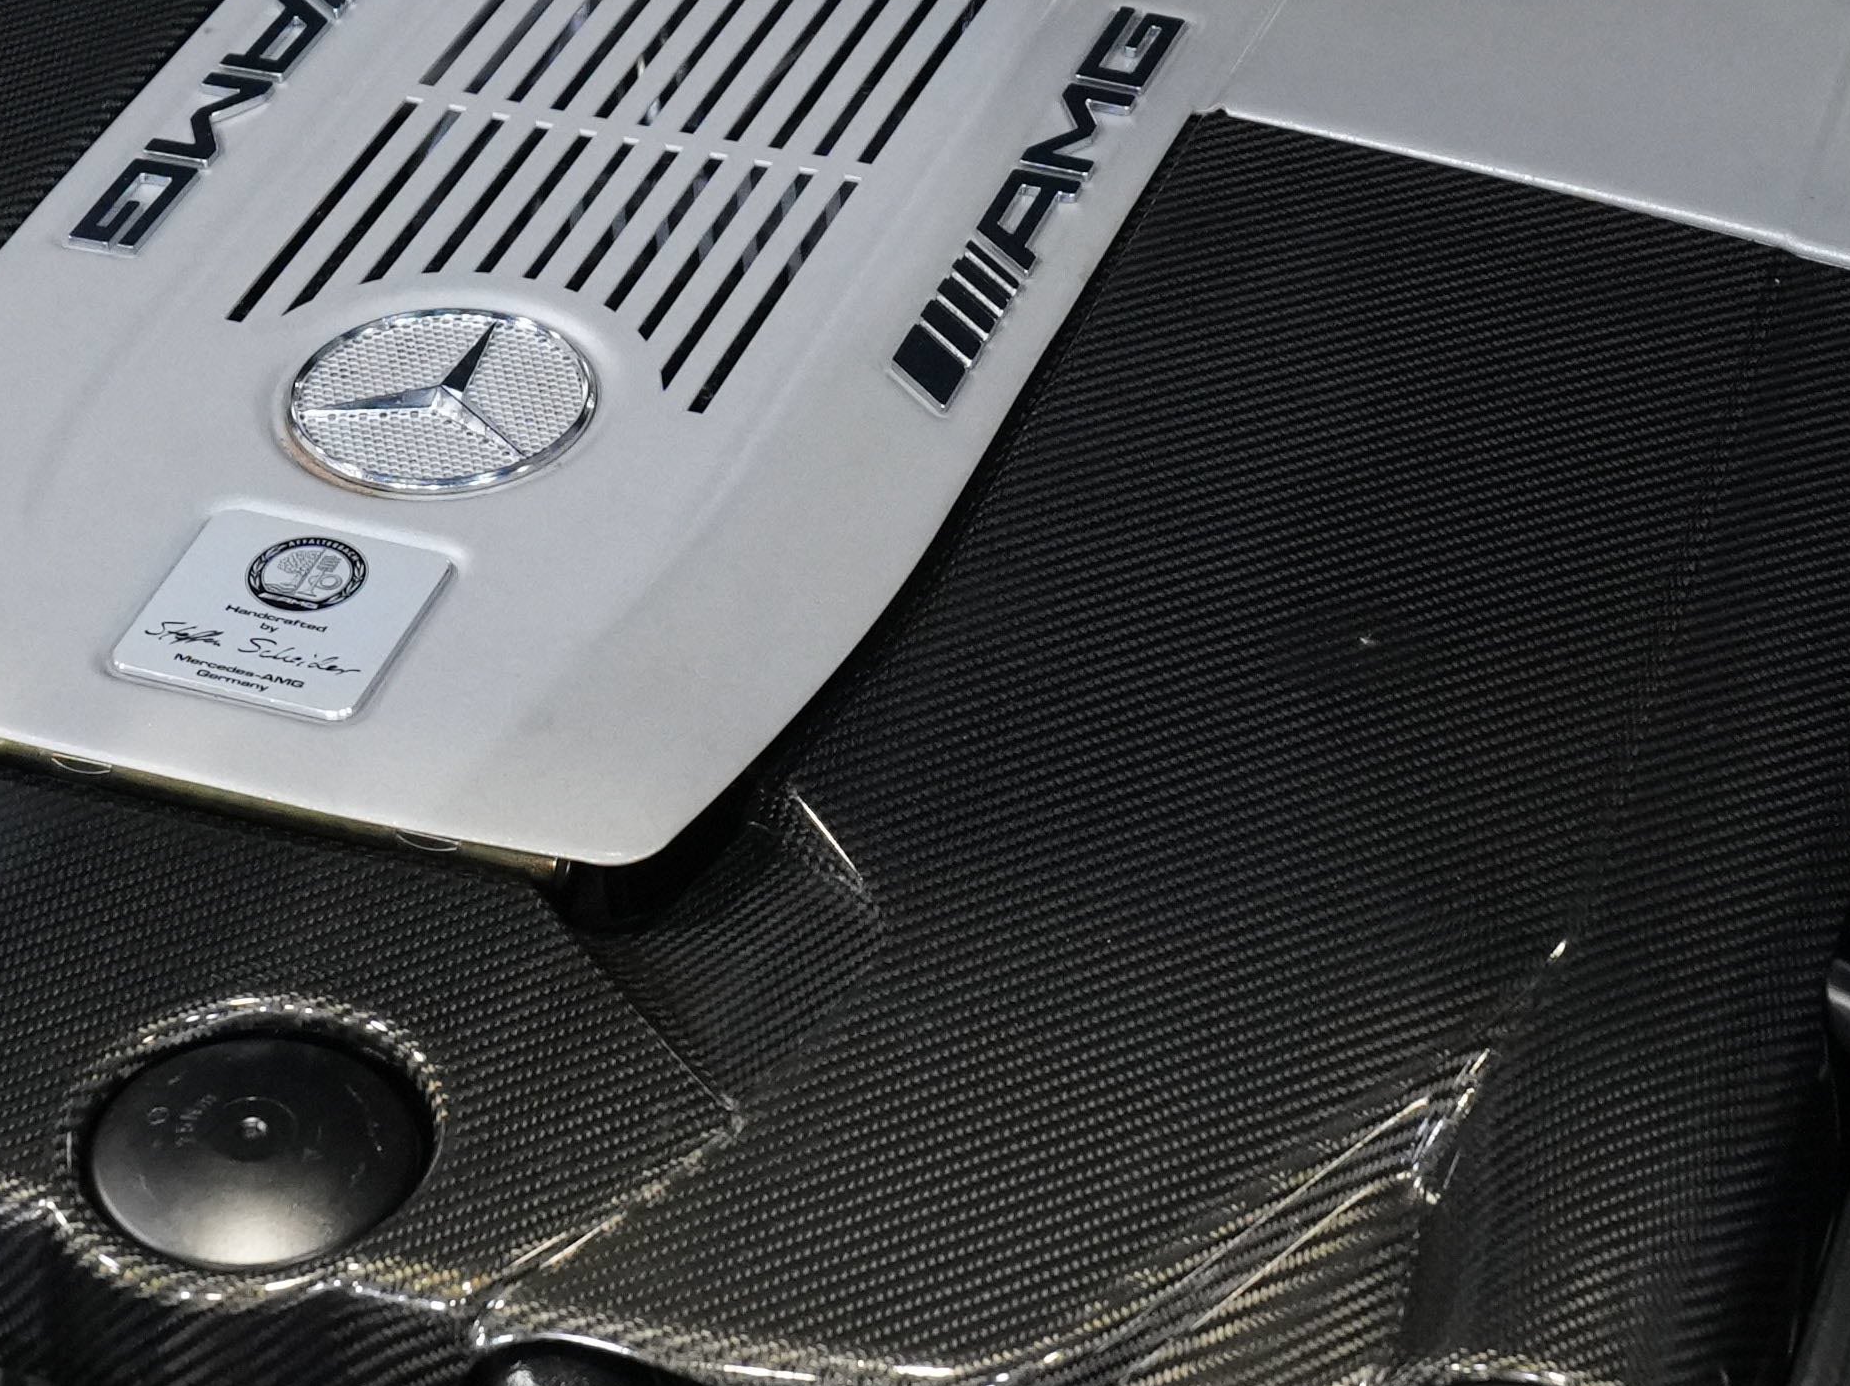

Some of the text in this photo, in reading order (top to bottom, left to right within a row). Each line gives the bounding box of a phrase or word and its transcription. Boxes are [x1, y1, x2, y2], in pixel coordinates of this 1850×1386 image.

[225, 604, 329, 633] Handcrafted
[259, 621, 280, 634] by
[174, 652, 305, 689] Mercedes-AMG
[196, 668, 269, 692] Germany
